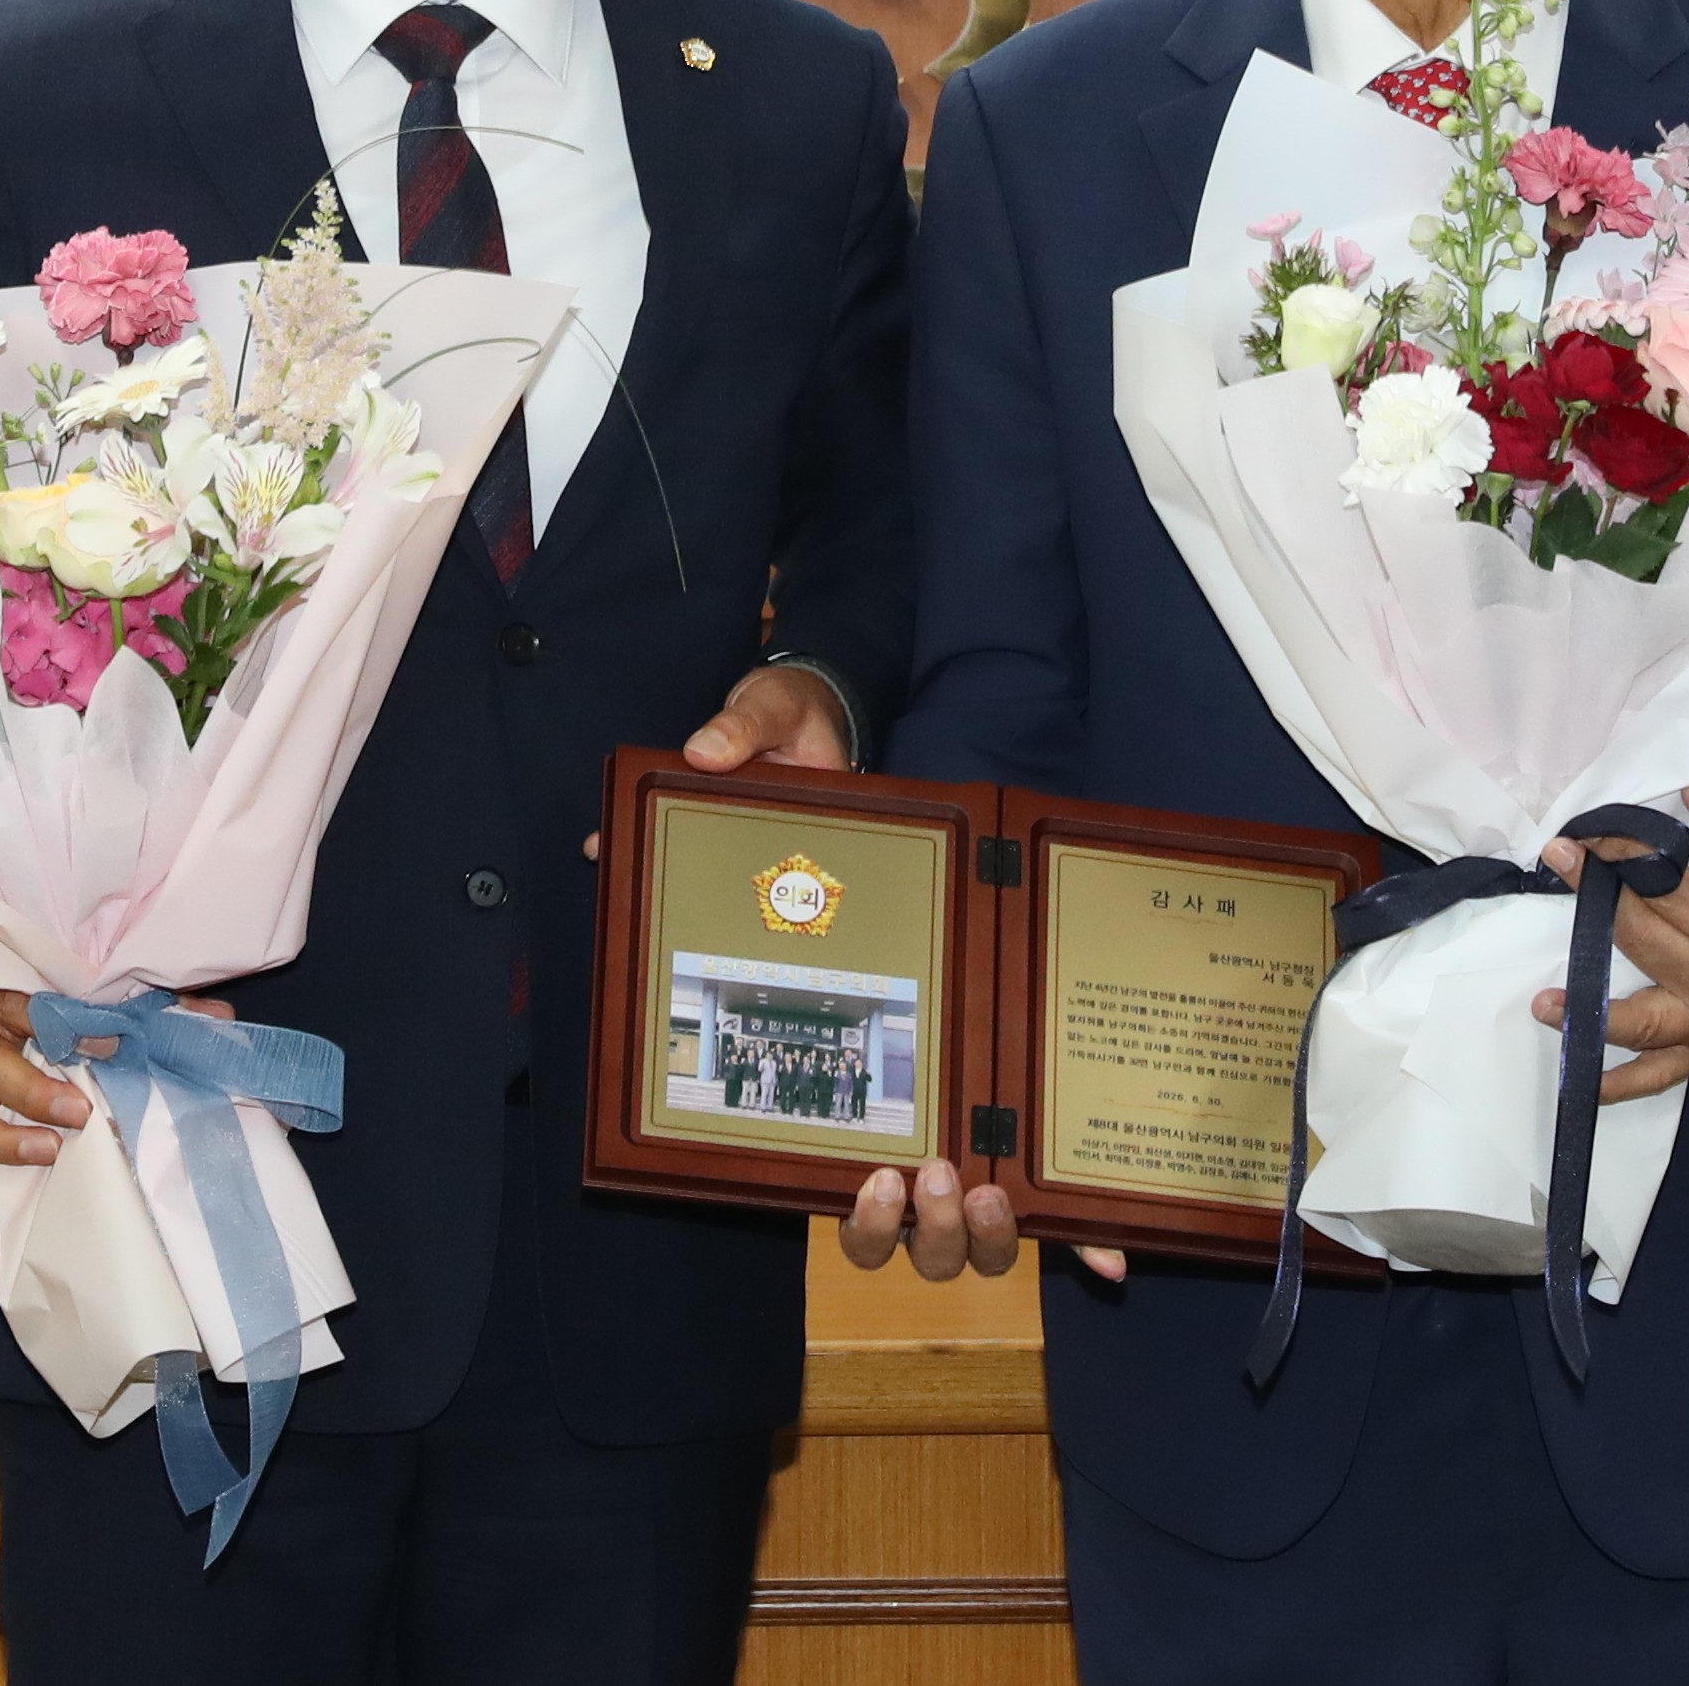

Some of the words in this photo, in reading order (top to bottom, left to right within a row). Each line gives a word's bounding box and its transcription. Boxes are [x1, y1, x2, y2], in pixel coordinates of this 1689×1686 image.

[774, 885, 819, 911] 의회
[702, 956, 800, 987] 울산광역시
[806, 968, 891, 996] 남구의회
[1208, 952, 1264, 970] 울산광역시
[1269, 959, 1315, 977] 남구청장
[1075, 980, 1092, 991] 지난
[1121, 986, 1148, 998] 남구의
[1289, 1009, 1307, 1020] 헌신
[1193, 1013, 1212, 1024] 남구
[1263, 1075, 1292, 1088] 기원합
[1157, 1090, 1187, 1103] 2026.
[1123, 1122, 1184, 1141] 울산광역시
[1189, 1131, 1237, 1149] 남구의회
[1241, 1138, 1265, 1152] 의원
